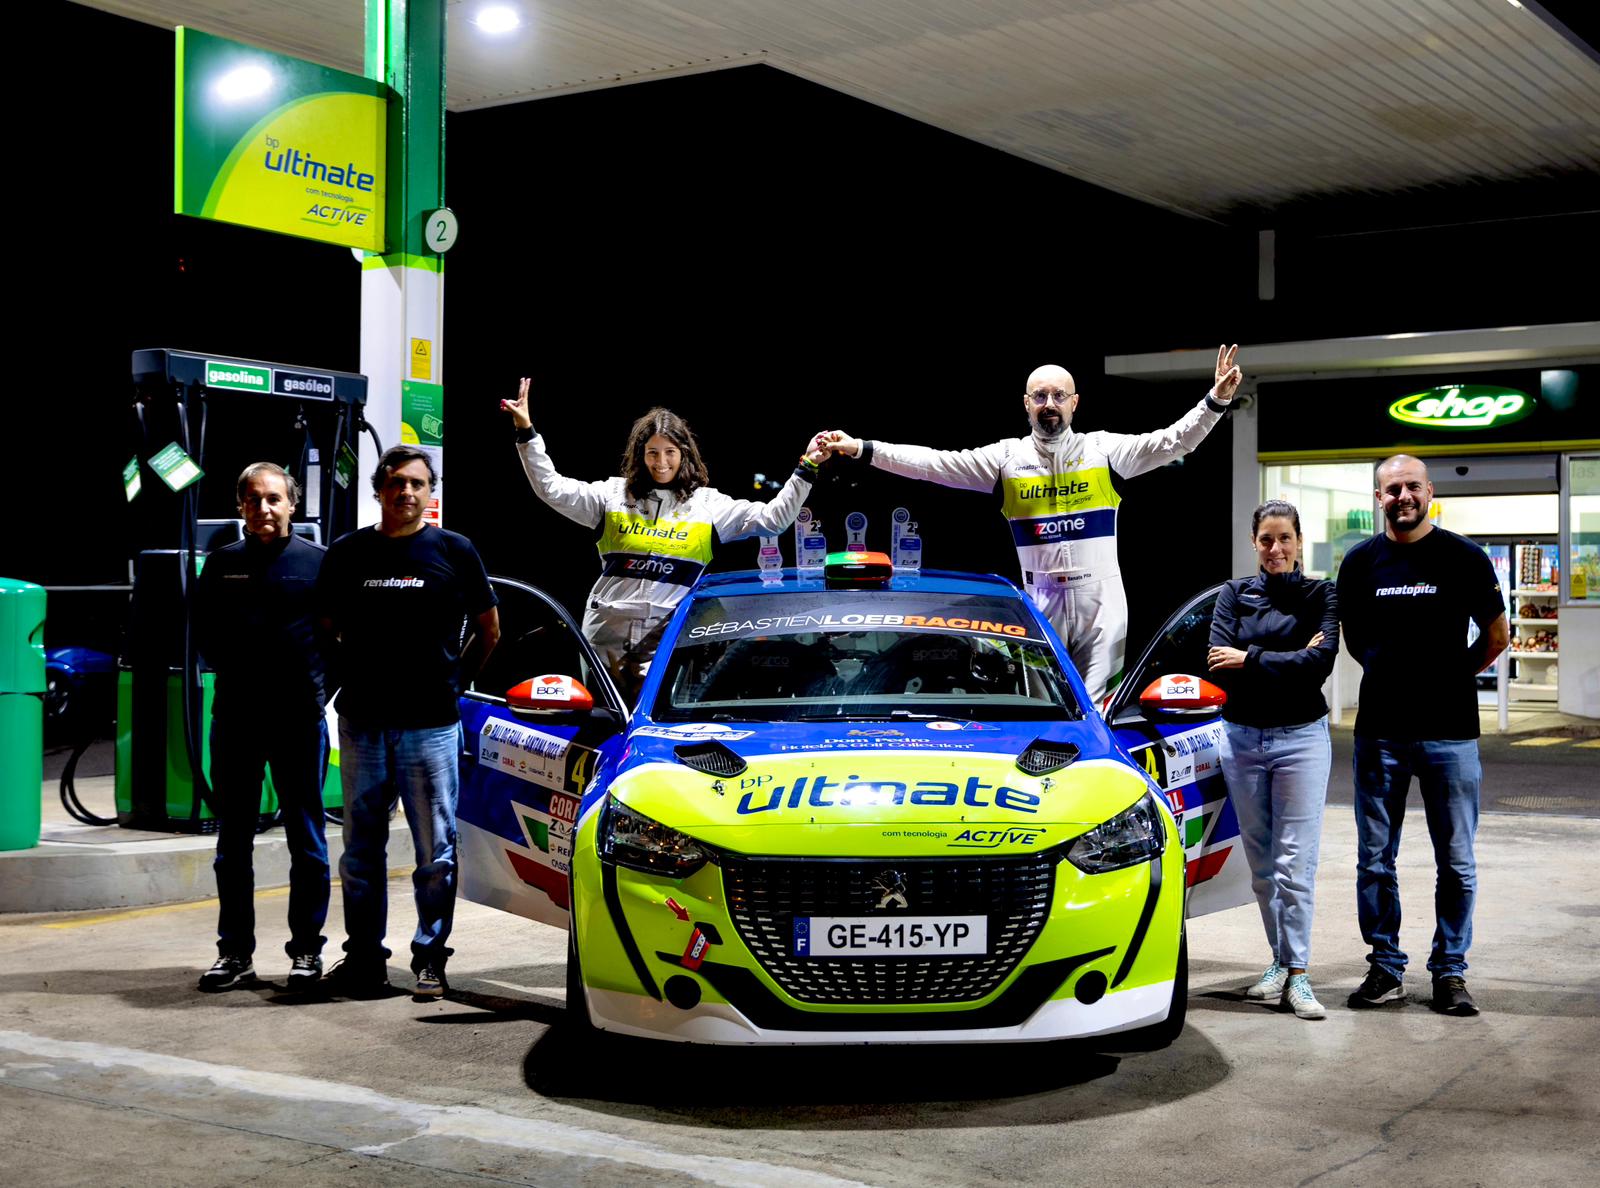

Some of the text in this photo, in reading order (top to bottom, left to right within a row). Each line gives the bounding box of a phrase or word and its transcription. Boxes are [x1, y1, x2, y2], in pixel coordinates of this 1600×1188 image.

[265, 134, 280, 150] bp
[264, 148, 375, 192] ultimate
[306, 187, 354, 203] com tecnologia
[307, 204, 367, 225] ACTIVE
[436, 220, 447, 242] 2
[209, 370, 331, 394] gasolina gasóleo
[1402, 388, 1524, 426] shop
[1020, 481, 1088, 499] ultimate
[618, 522, 689, 541] ultimate
[1034, 518, 1086, 535] zome
[624, 559, 674, 575] zome
[363, 577, 425, 589] renatopita
[1375, 583, 1437, 597] renatopita
[536, 686, 565, 696] BDR
[1167, 686, 1195, 695] BDR
[572, 751, 590, 794] 4
[1145, 748, 1160, 781] 4
[740, 774, 773, 790] bp
[736, 774, 1041, 815] ultimate
[903, 830, 948, 839] tecnologia
[954, 830, 1038, 845] ACTIVE
[797, 938, 807, 951] F
[827, 923, 970, 949] GE-415-YP
